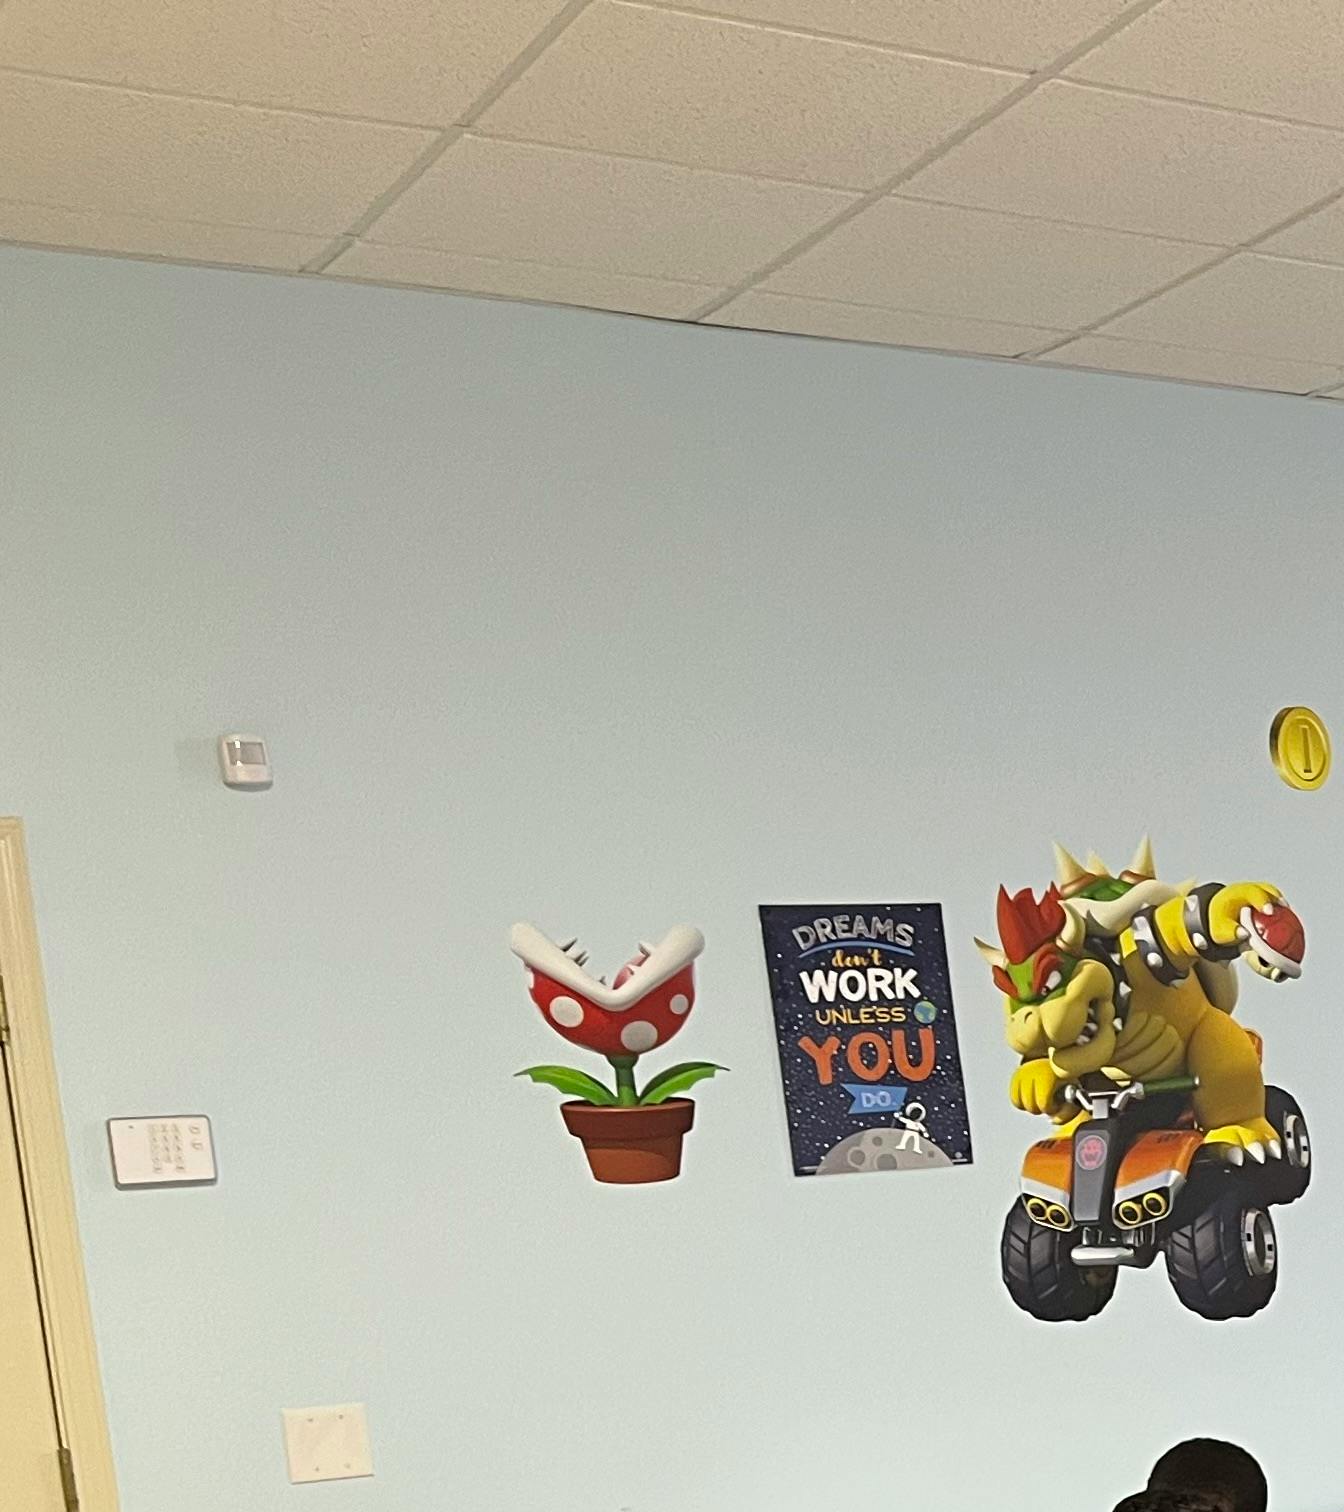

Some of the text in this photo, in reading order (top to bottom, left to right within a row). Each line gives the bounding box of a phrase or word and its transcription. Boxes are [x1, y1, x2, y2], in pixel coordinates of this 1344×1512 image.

[792, 914, 914, 950] DREAMS
[831, 949, 883, 967] don't
[799, 967, 921, 1003] WORK
[815, 1005, 906, 1025] UNLESS
[797, 1027, 936, 1085] YOU
